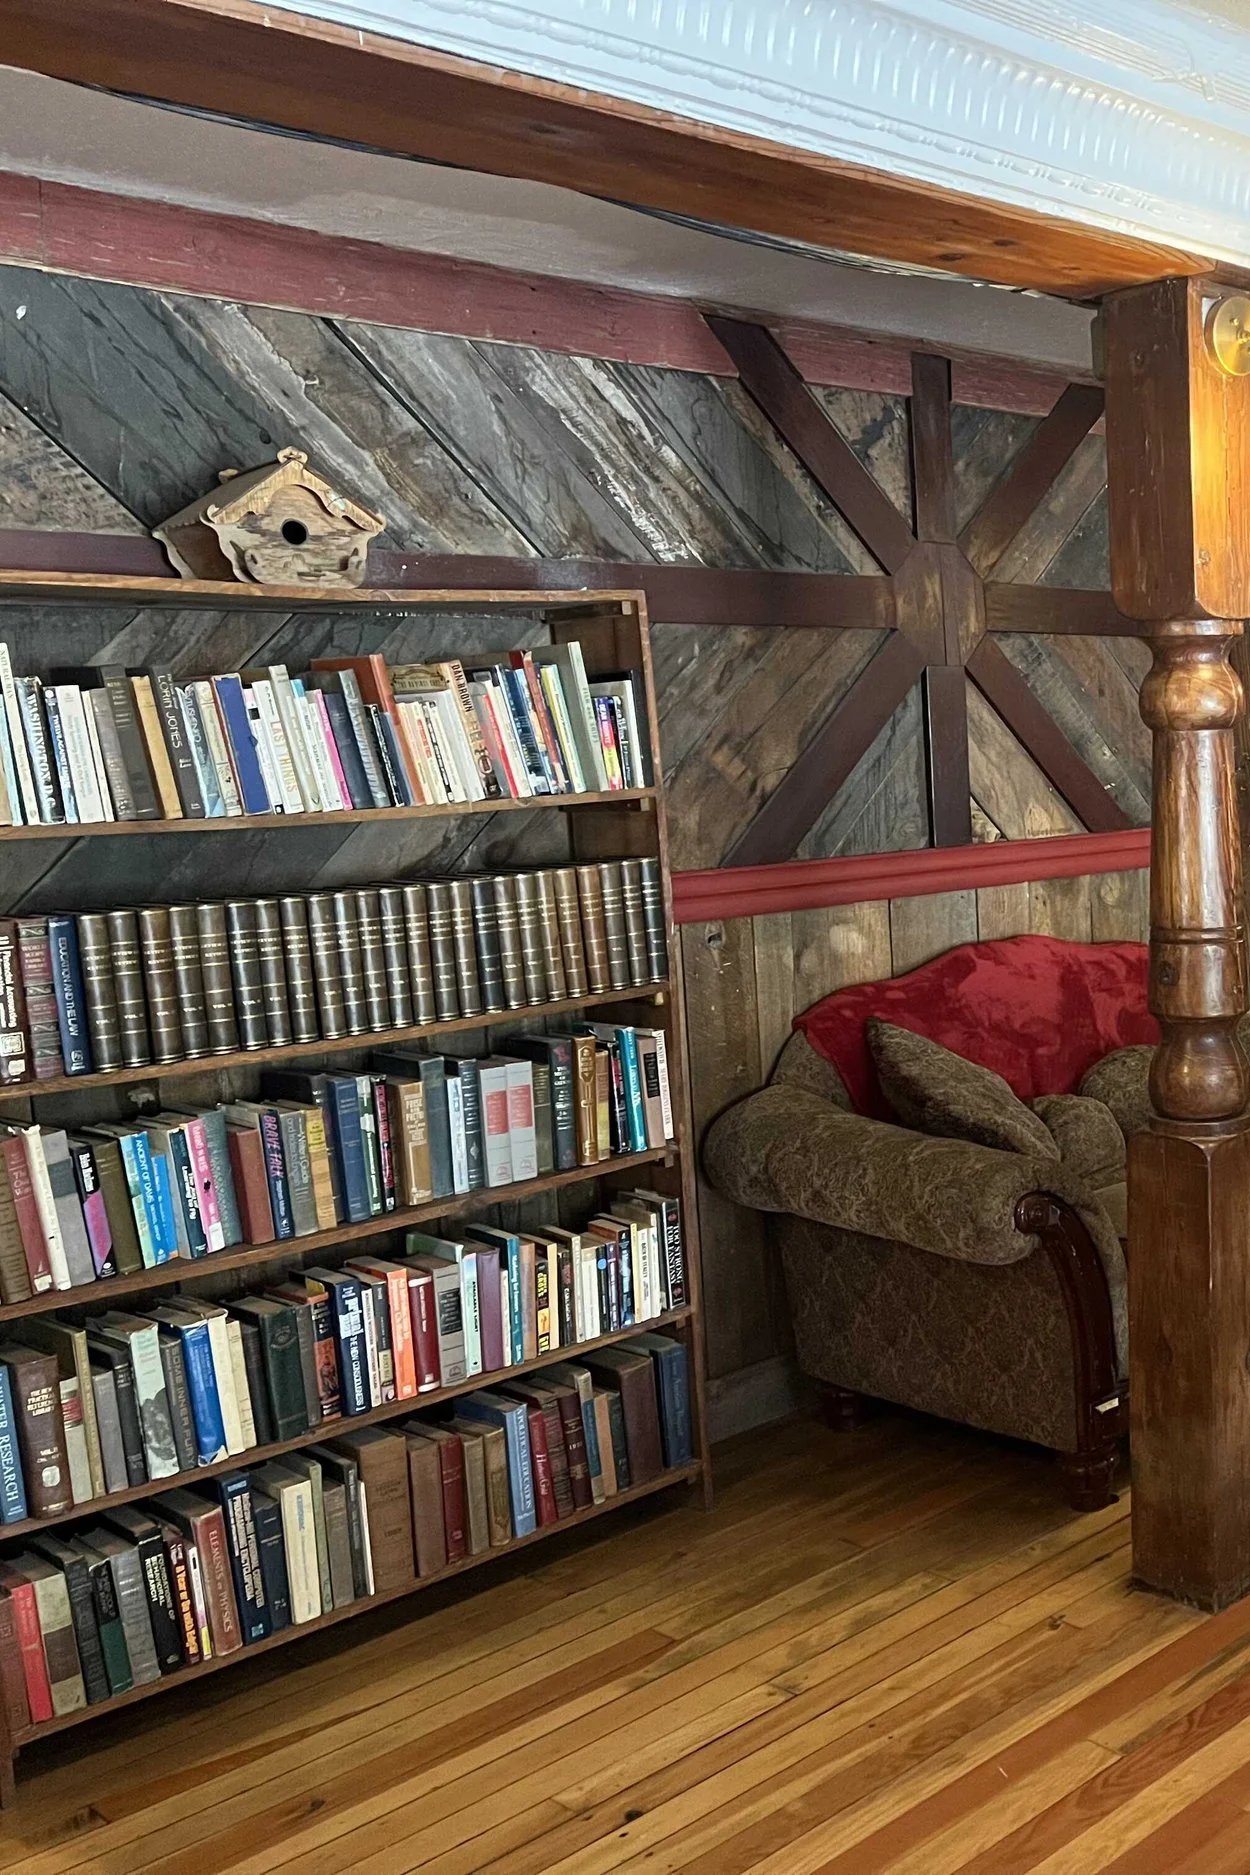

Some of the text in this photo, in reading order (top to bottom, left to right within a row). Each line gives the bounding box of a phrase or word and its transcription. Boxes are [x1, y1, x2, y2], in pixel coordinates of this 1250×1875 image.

[156, 674, 183, 749] LORIN JONES
[451, 663, 473, 712] DAN BROWN
[269, 720, 300, 793] LAST THINGS
[2, 950, 17, 1027] Financial Accounting
[56, 936, 78, 1036] EDUCATION AND THE LAW
[262, 1114, 280, 1150] BRAVE
[133, 1139, 147, 1171] ANCIENT
[142, 1182, 154, 1203] DAYS
[268, 1152, 284, 1179] TALK
[666, 1245, 677, 1284] FANTASY
[671, 1224, 683, 1283] TOO STRONG
[168, 1345, 199, 1464] SOME INNER FURY
[516, 1415, 527, 1460] POLITICAL
[0, 1434, 18, 1501] RESEARCH
[520, 1461, 532, 1510] EDUCATION
[231, 1495, 248, 1549] PROGRAMMING
[237, 1548, 255, 1601] ENCYCLOPEDIA
[245, 1533, 260, 1569] PERSONAL
[143, 1557, 158, 1602] RESEARCH
[149, 1555, 165, 1606] BEHAVIORAL
[156, 1553, 173, 1608] FOUNDATIONS
[206, 1529, 225, 1579] ELEMENTS
[216, 1590, 234, 1633] PHYSICS
[250, 1568, 266, 1607] COMPUTER
